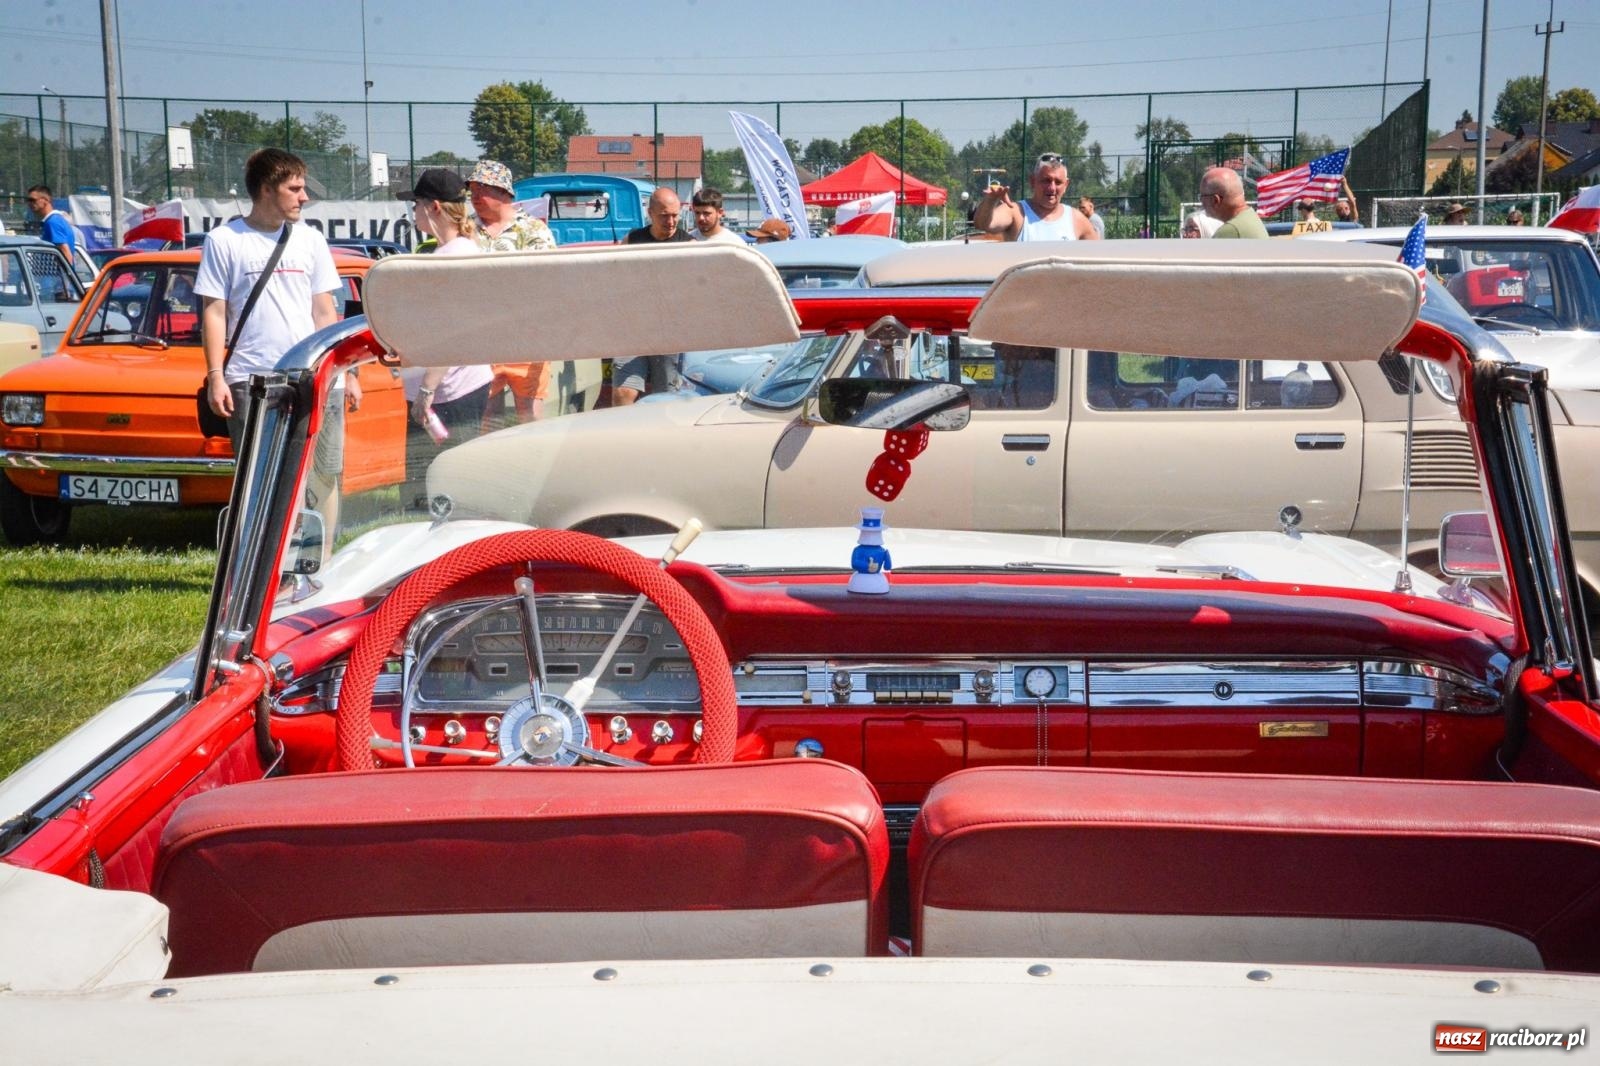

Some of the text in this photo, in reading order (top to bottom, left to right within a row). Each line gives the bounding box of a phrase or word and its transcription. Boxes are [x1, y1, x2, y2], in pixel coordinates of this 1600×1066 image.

[1297, 222, 1328, 233] TAXI
[73, 478, 175, 501] S4 ZOCHA
